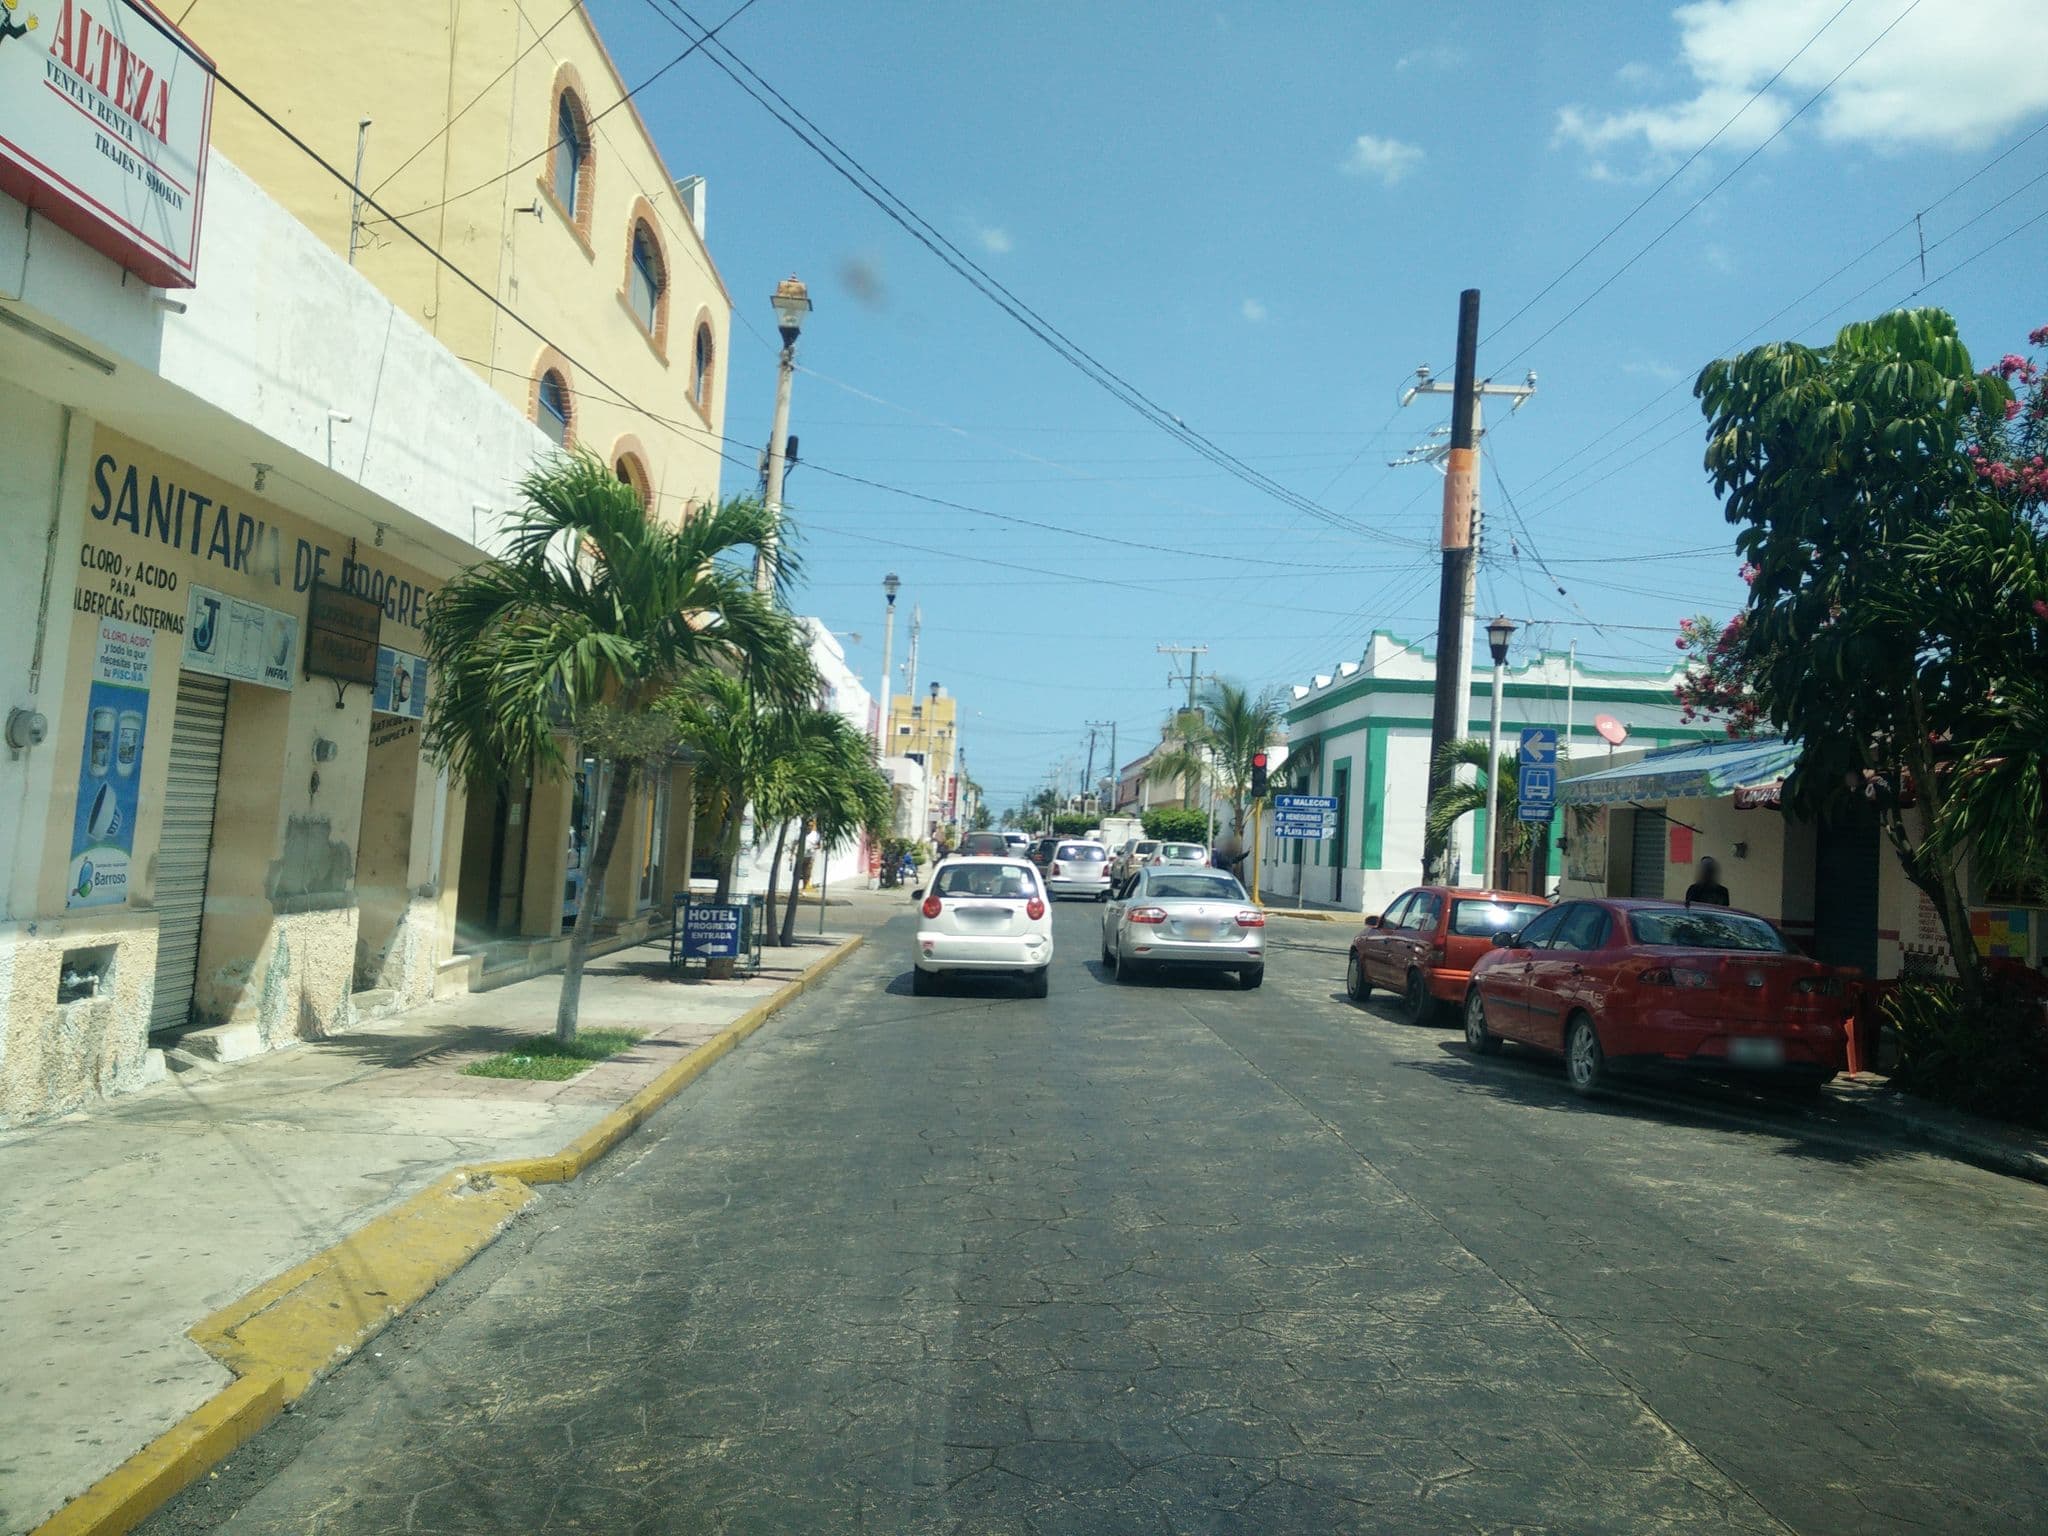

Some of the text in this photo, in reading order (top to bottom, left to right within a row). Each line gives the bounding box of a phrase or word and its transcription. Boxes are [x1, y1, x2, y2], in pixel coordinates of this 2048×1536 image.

[49, 0, 167, 145] ALTEZA
[47, 59, 133, 142] VENTA Y RENTA
[95, 132, 183, 211] TRAJES Y SMOKIN
[80, 543, 122, 575] CLORO
[136, 561, 177, 591] ACIDO
[110, 578, 136, 598] PARA
[133, 603, 185, 634] CISTERNAS
[110, 643, 125, 655] todo
[100, 655, 130, 668] necesitas
[95, 871, 127, 886] Barroso
[688, 909, 738, 921] HOTEL
[687, 922, 737, 930] PROGRESO
[691, 931, 733, 940] ENTRADA
